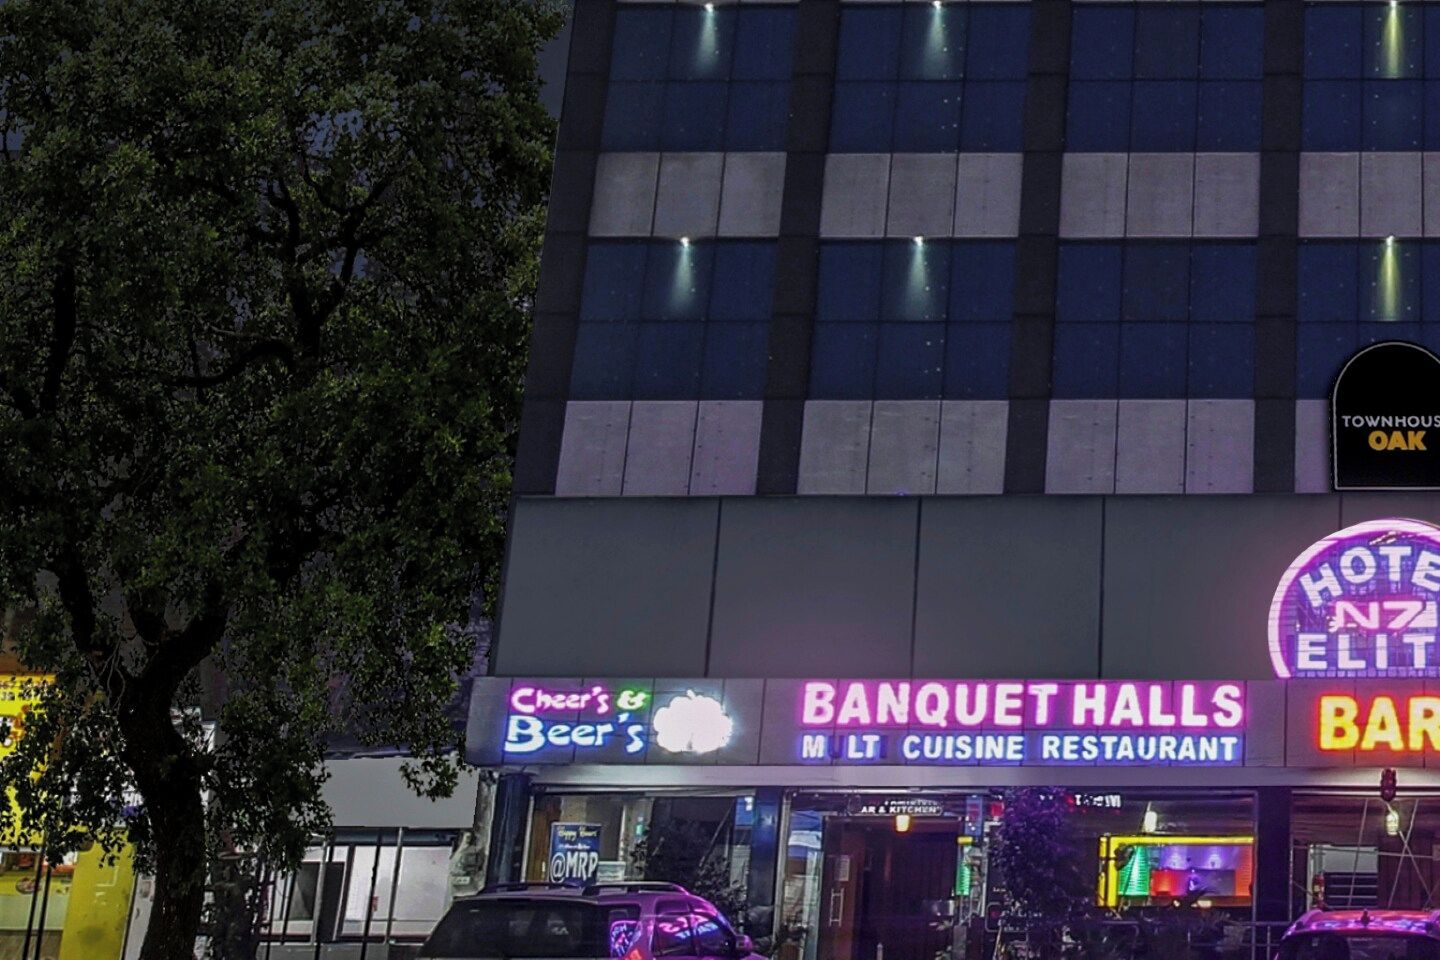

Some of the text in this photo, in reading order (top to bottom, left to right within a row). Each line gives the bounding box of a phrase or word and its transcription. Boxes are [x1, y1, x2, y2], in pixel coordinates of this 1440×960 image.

[1368, 430, 1427, 451] OAK
[511, 686, 648, 714] Cheer's &
[802, 682, 1243, 727] BANQUET HALLS
[504, 712, 644, 753] Beer's
[903, 735, 1025, 759] CUISINE
[1042, 735, 1238, 761] RESTAURANT
[550, 851, 599, 884] @MRP
